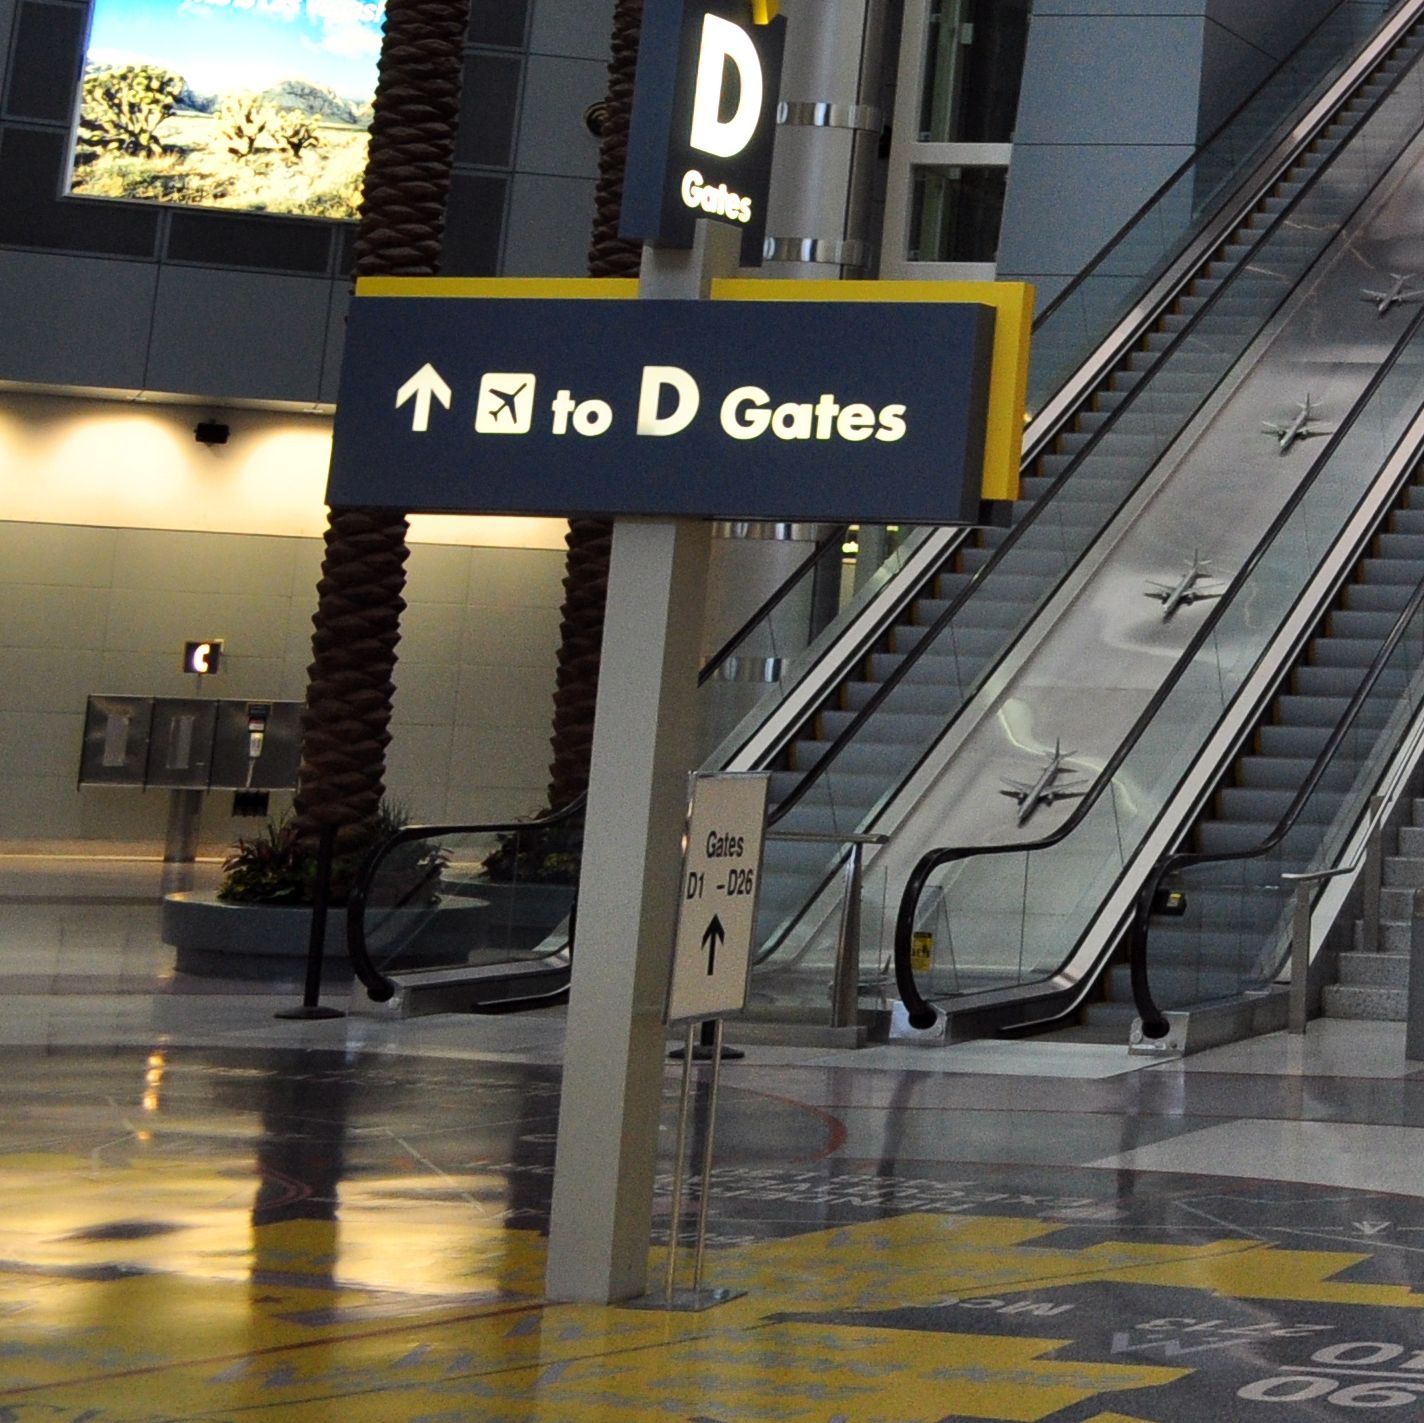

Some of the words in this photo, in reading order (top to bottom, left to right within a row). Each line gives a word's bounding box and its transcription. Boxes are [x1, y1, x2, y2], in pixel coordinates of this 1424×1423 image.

[690, 12, 763, 158] D
[681, 169, 752, 223] Gates
[552, 390, 613, 437] to
[637, 366, 700, 435] D
[720, 386, 907, 442] Gates
[706, 830, 744, 858] Gates
[686, 871, 705, 900] D1
